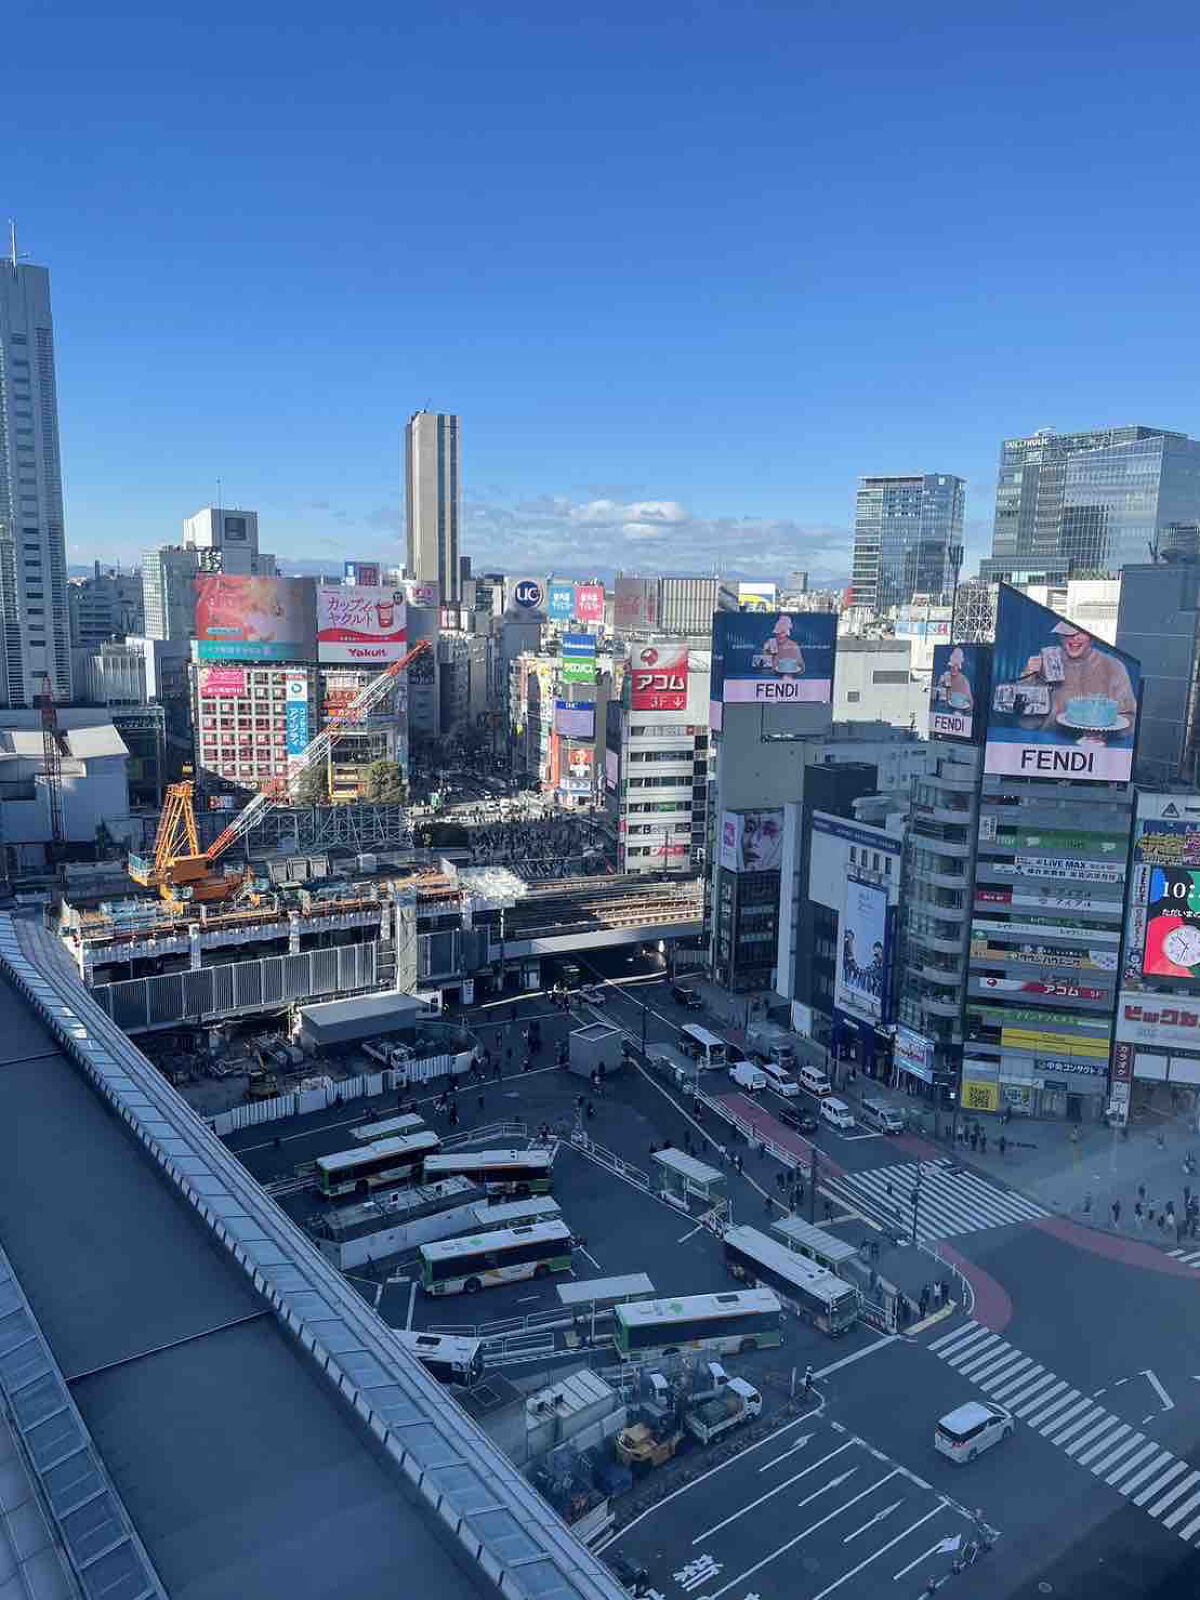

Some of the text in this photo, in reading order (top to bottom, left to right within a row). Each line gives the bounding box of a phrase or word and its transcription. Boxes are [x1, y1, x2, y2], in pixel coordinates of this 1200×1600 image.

[347, 648, 386, 657] Yakult
[636, 674, 686, 691] アコム
[755, 683, 799, 698] FENDI
[934, 714, 965, 732] FENDI
[1020, 749, 1094, 773] FENDI
[1162, 881, 1200, 899] 10:
[1043, 984, 1080, 997] アコム
